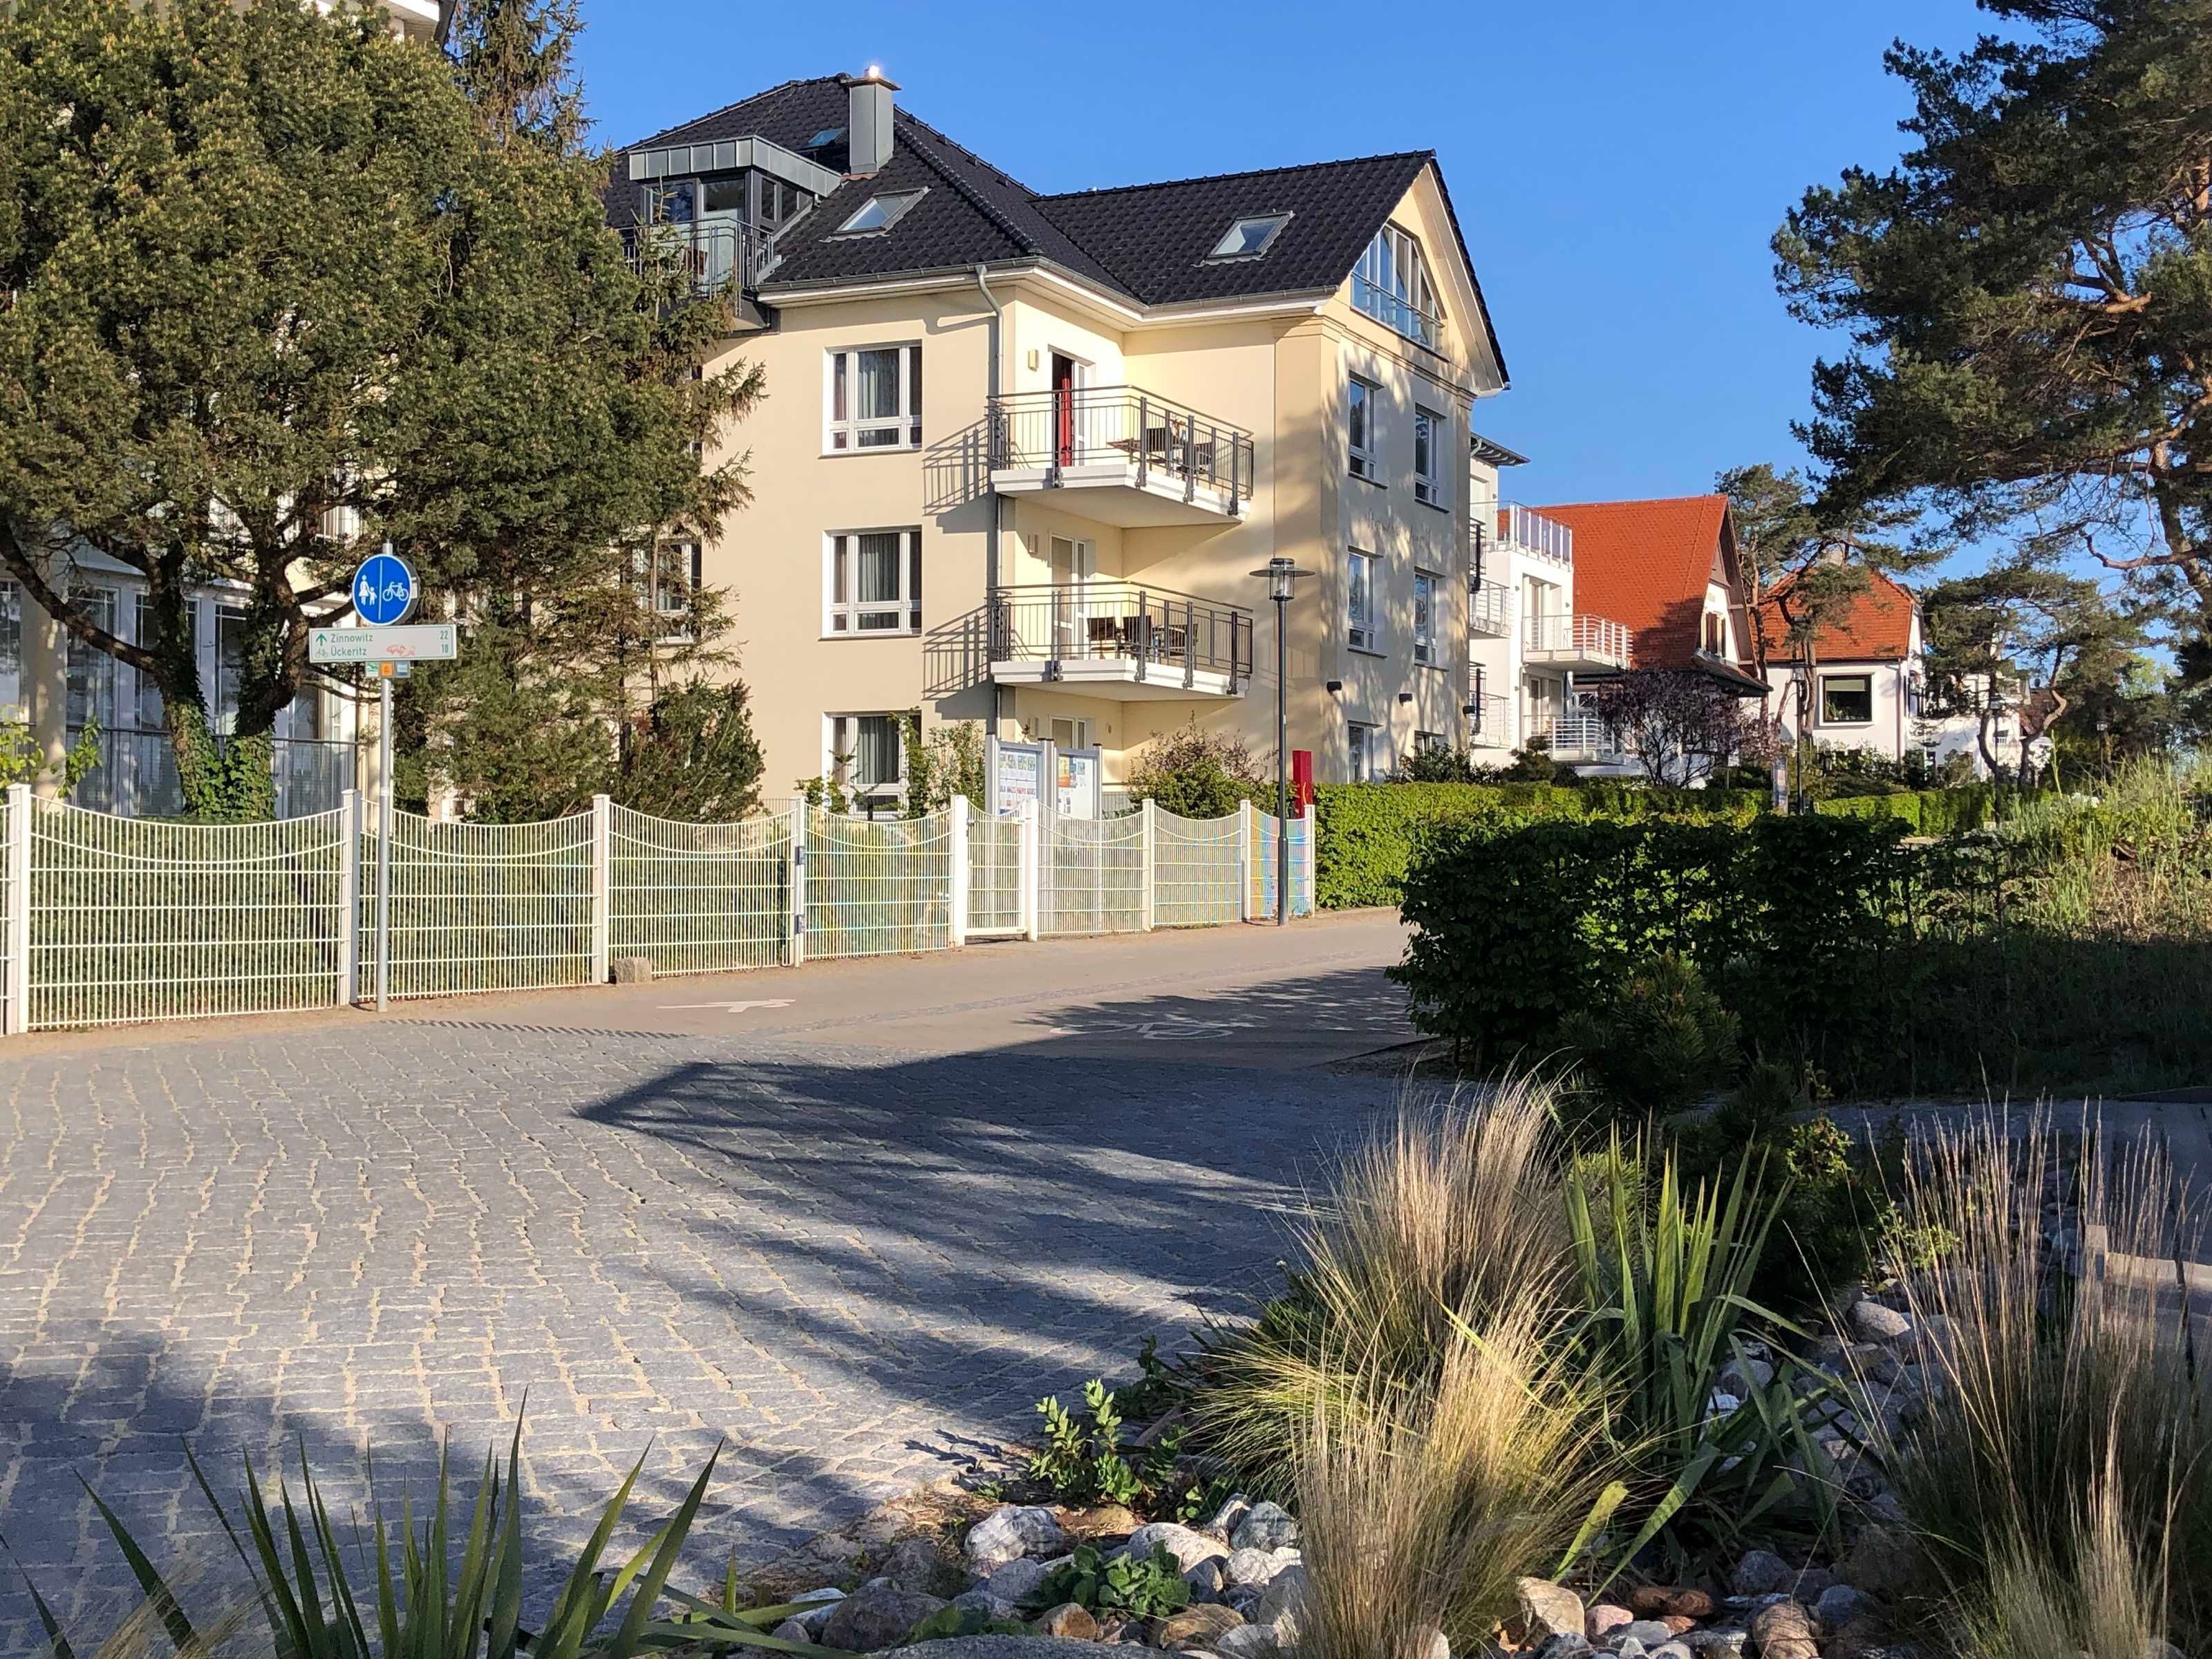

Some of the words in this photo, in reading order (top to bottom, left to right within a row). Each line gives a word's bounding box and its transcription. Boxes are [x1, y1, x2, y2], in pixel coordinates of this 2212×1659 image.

[330, 633, 373, 643] Zinnowitz
[440, 630, 449, 639] 22
[330, 645, 367, 657] Ückeritz
